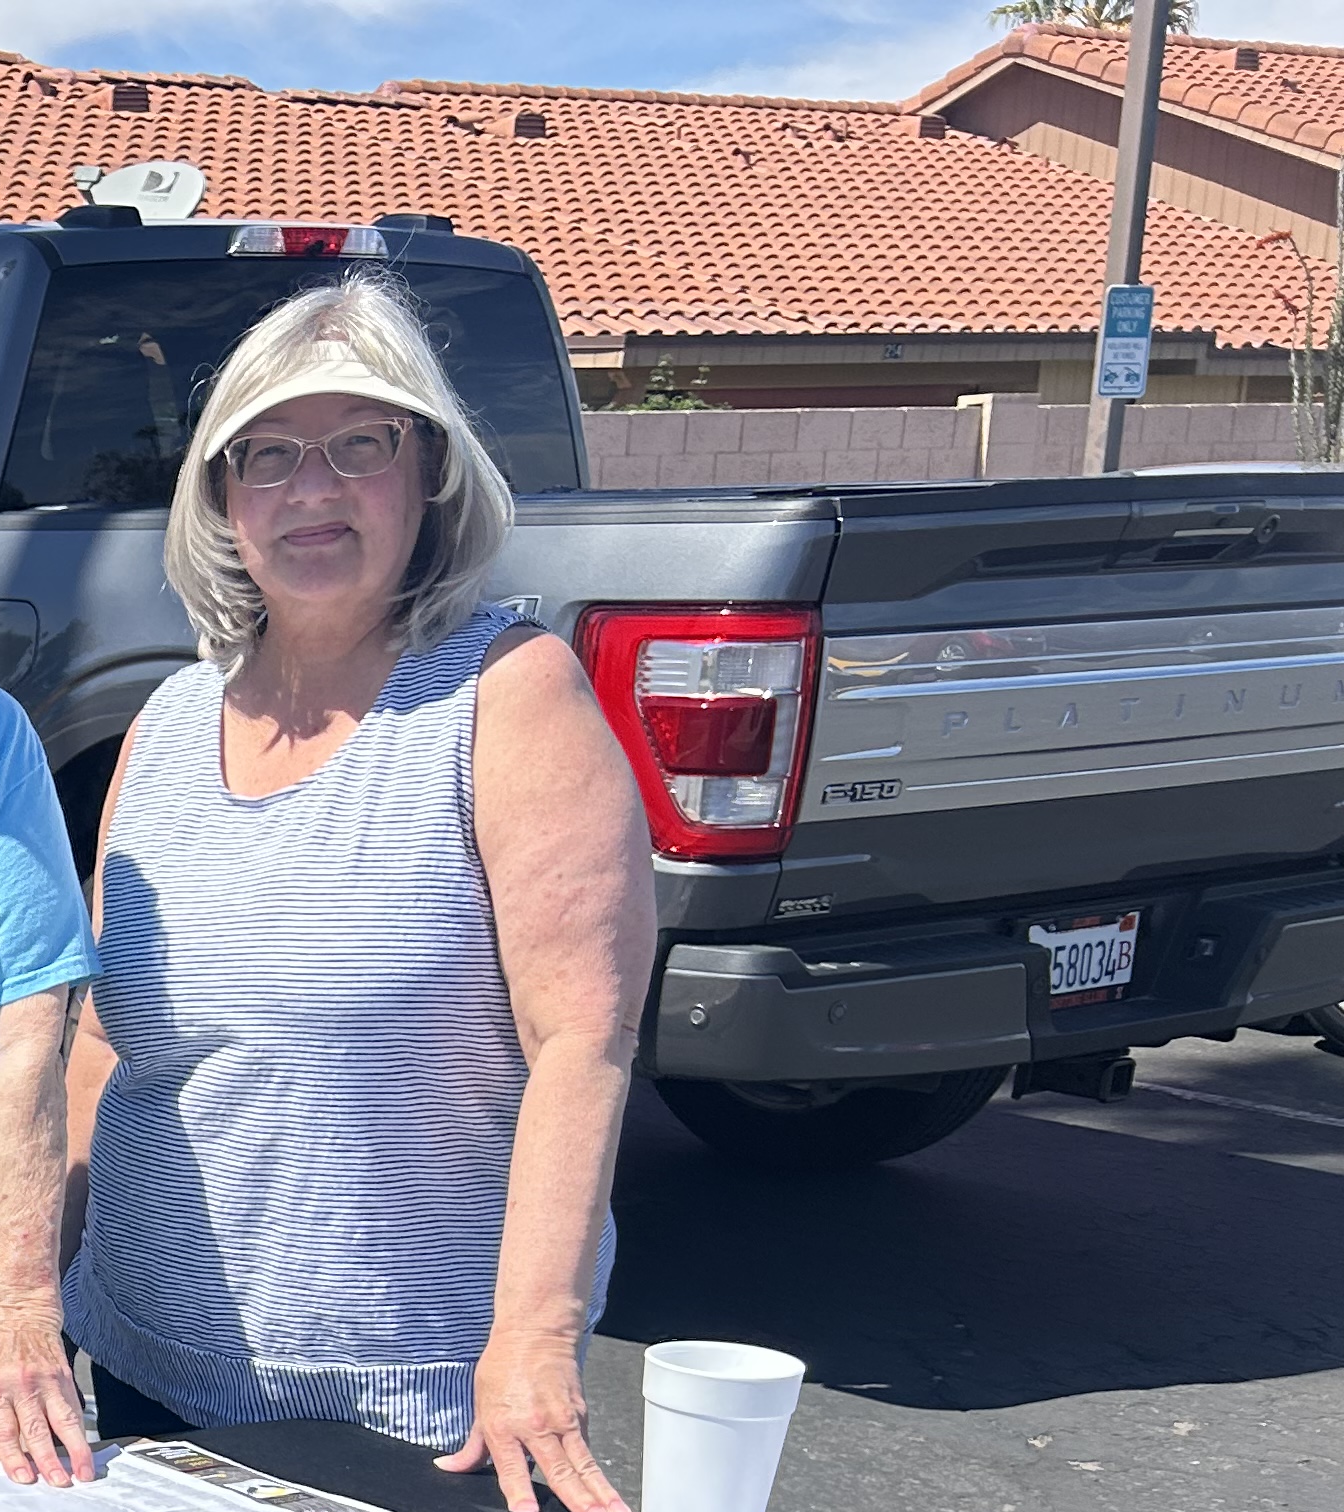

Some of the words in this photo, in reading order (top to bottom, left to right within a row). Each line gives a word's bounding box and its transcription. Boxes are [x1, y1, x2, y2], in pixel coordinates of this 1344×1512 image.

[1111, 306, 1146, 320] PARKING
[1116, 320, 1139, 333] ONLY
[821, 779, 904, 806] F-150
